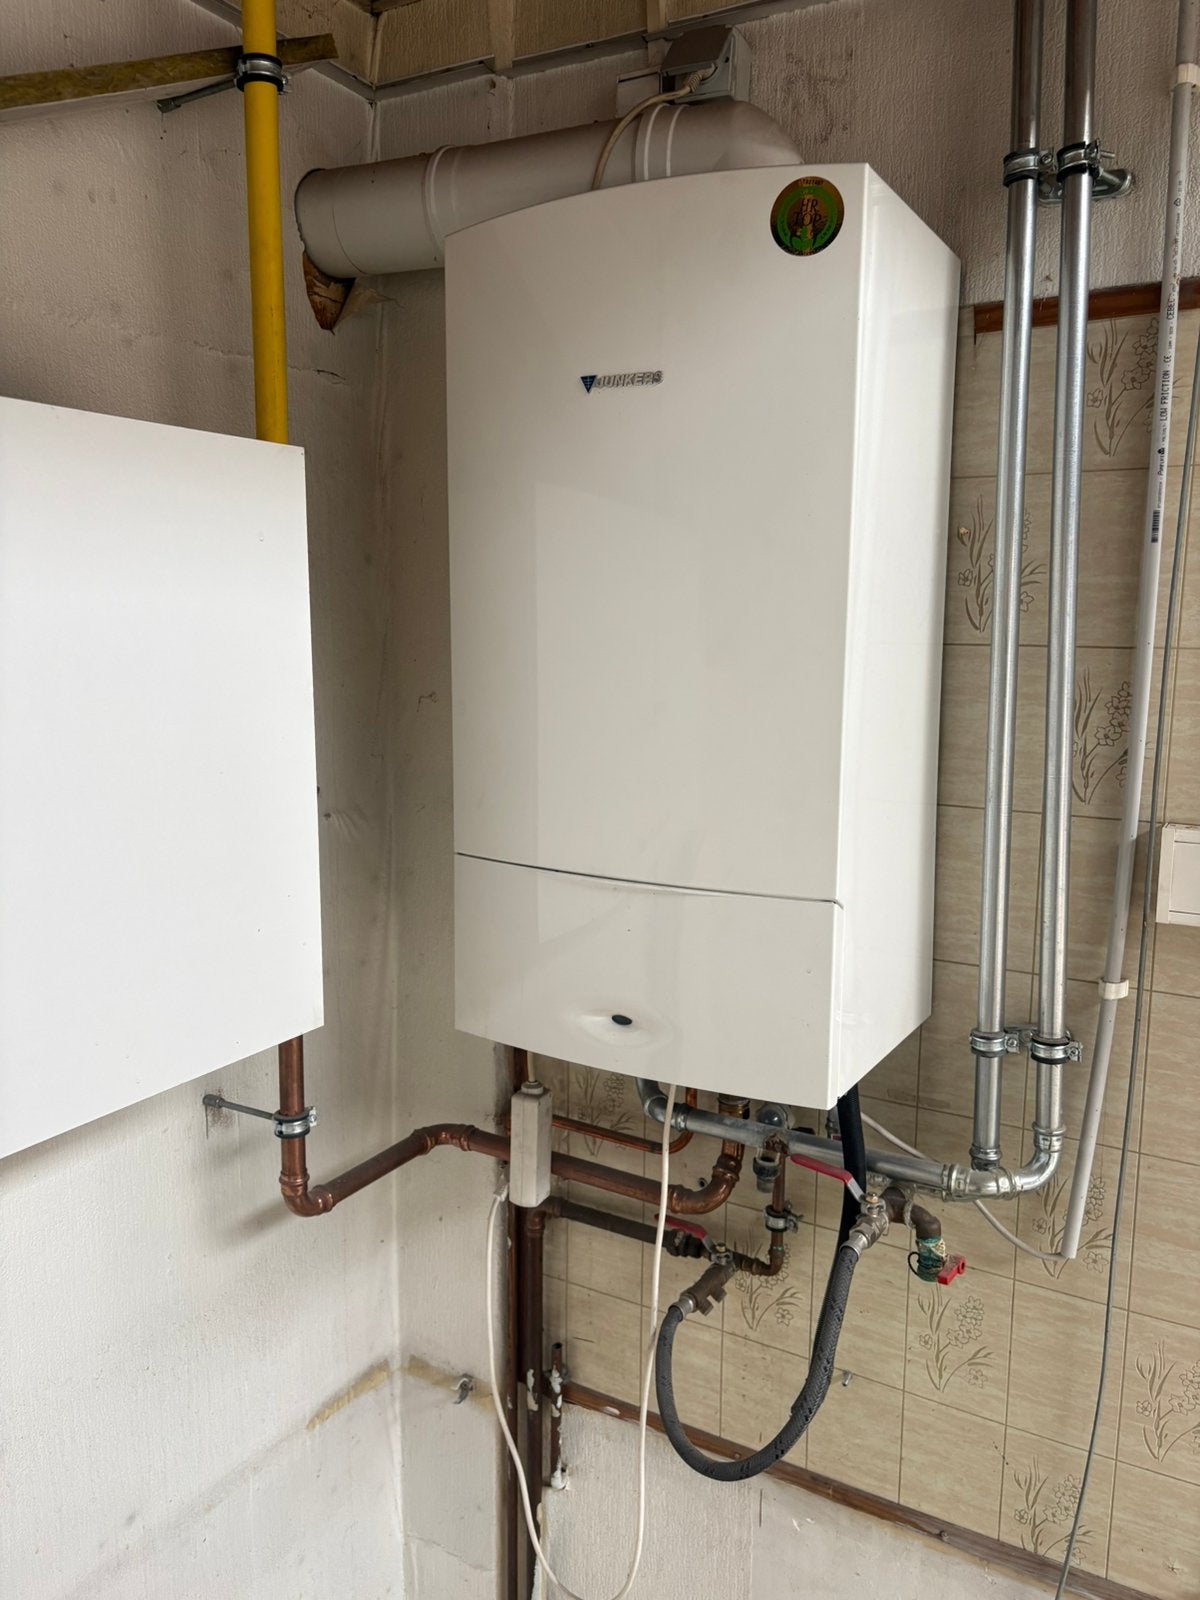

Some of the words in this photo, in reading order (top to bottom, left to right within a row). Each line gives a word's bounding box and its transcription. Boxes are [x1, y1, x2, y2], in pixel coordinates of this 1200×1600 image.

[594, 370, 663, 389] JUNKERS
[1160, 370, 1170, 404] FRICTION
[1160, 407, 1168, 421] LOW
